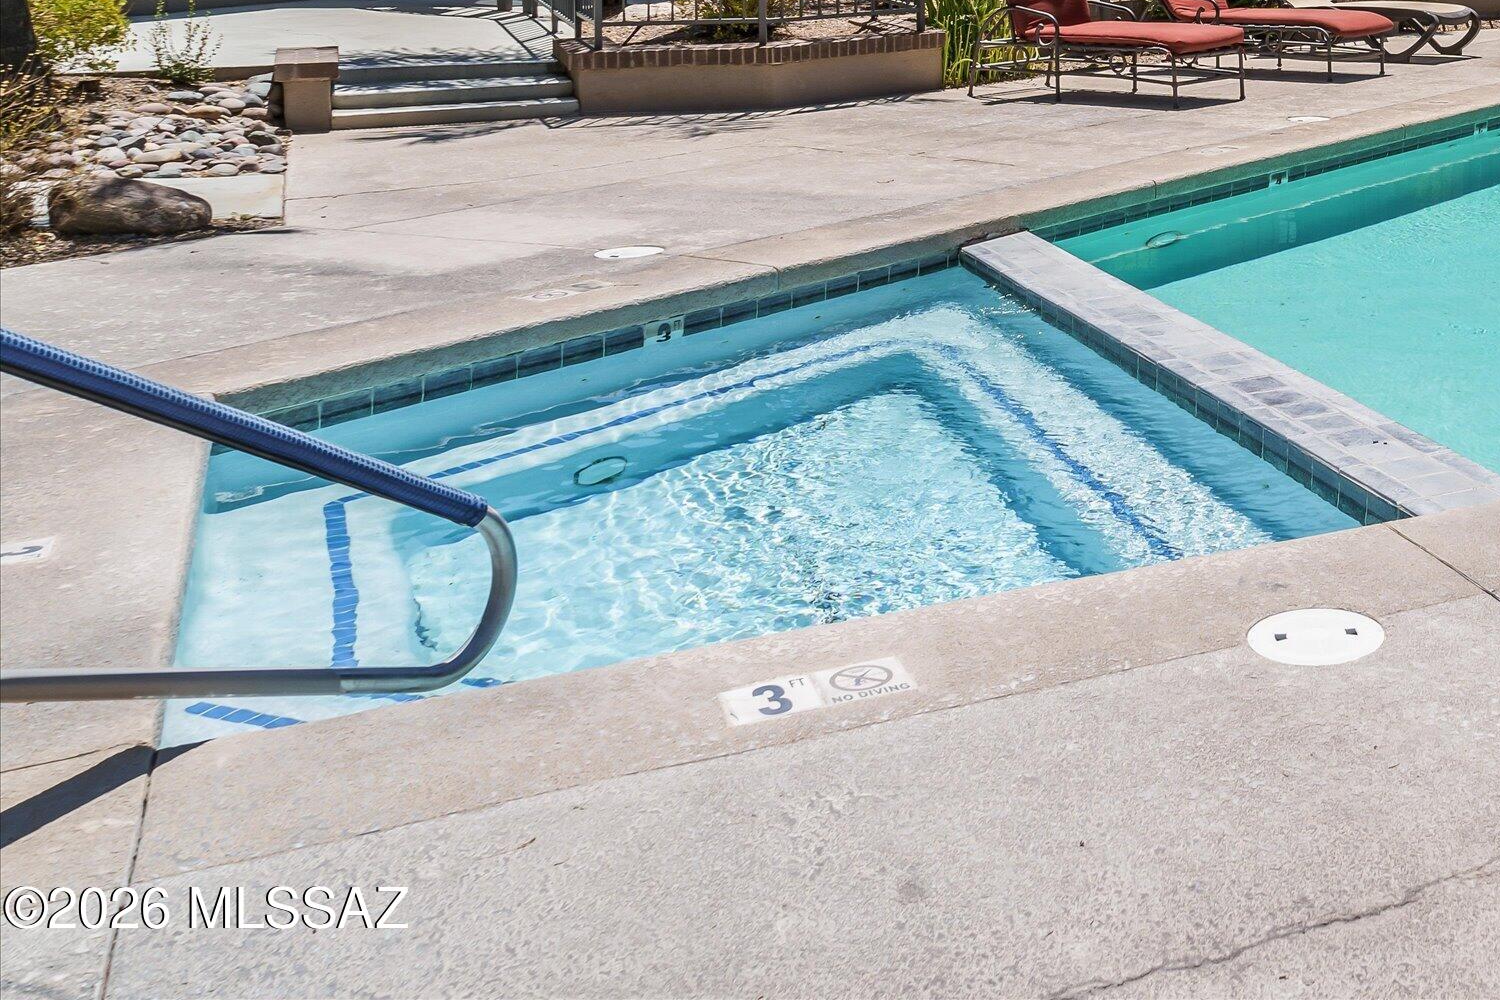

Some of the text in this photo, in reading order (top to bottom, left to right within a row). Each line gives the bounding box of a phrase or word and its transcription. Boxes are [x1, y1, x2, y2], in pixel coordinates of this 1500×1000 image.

[752, 677, 805, 716] 3 FT
[831, 682, 911, 704] NO DIVING
